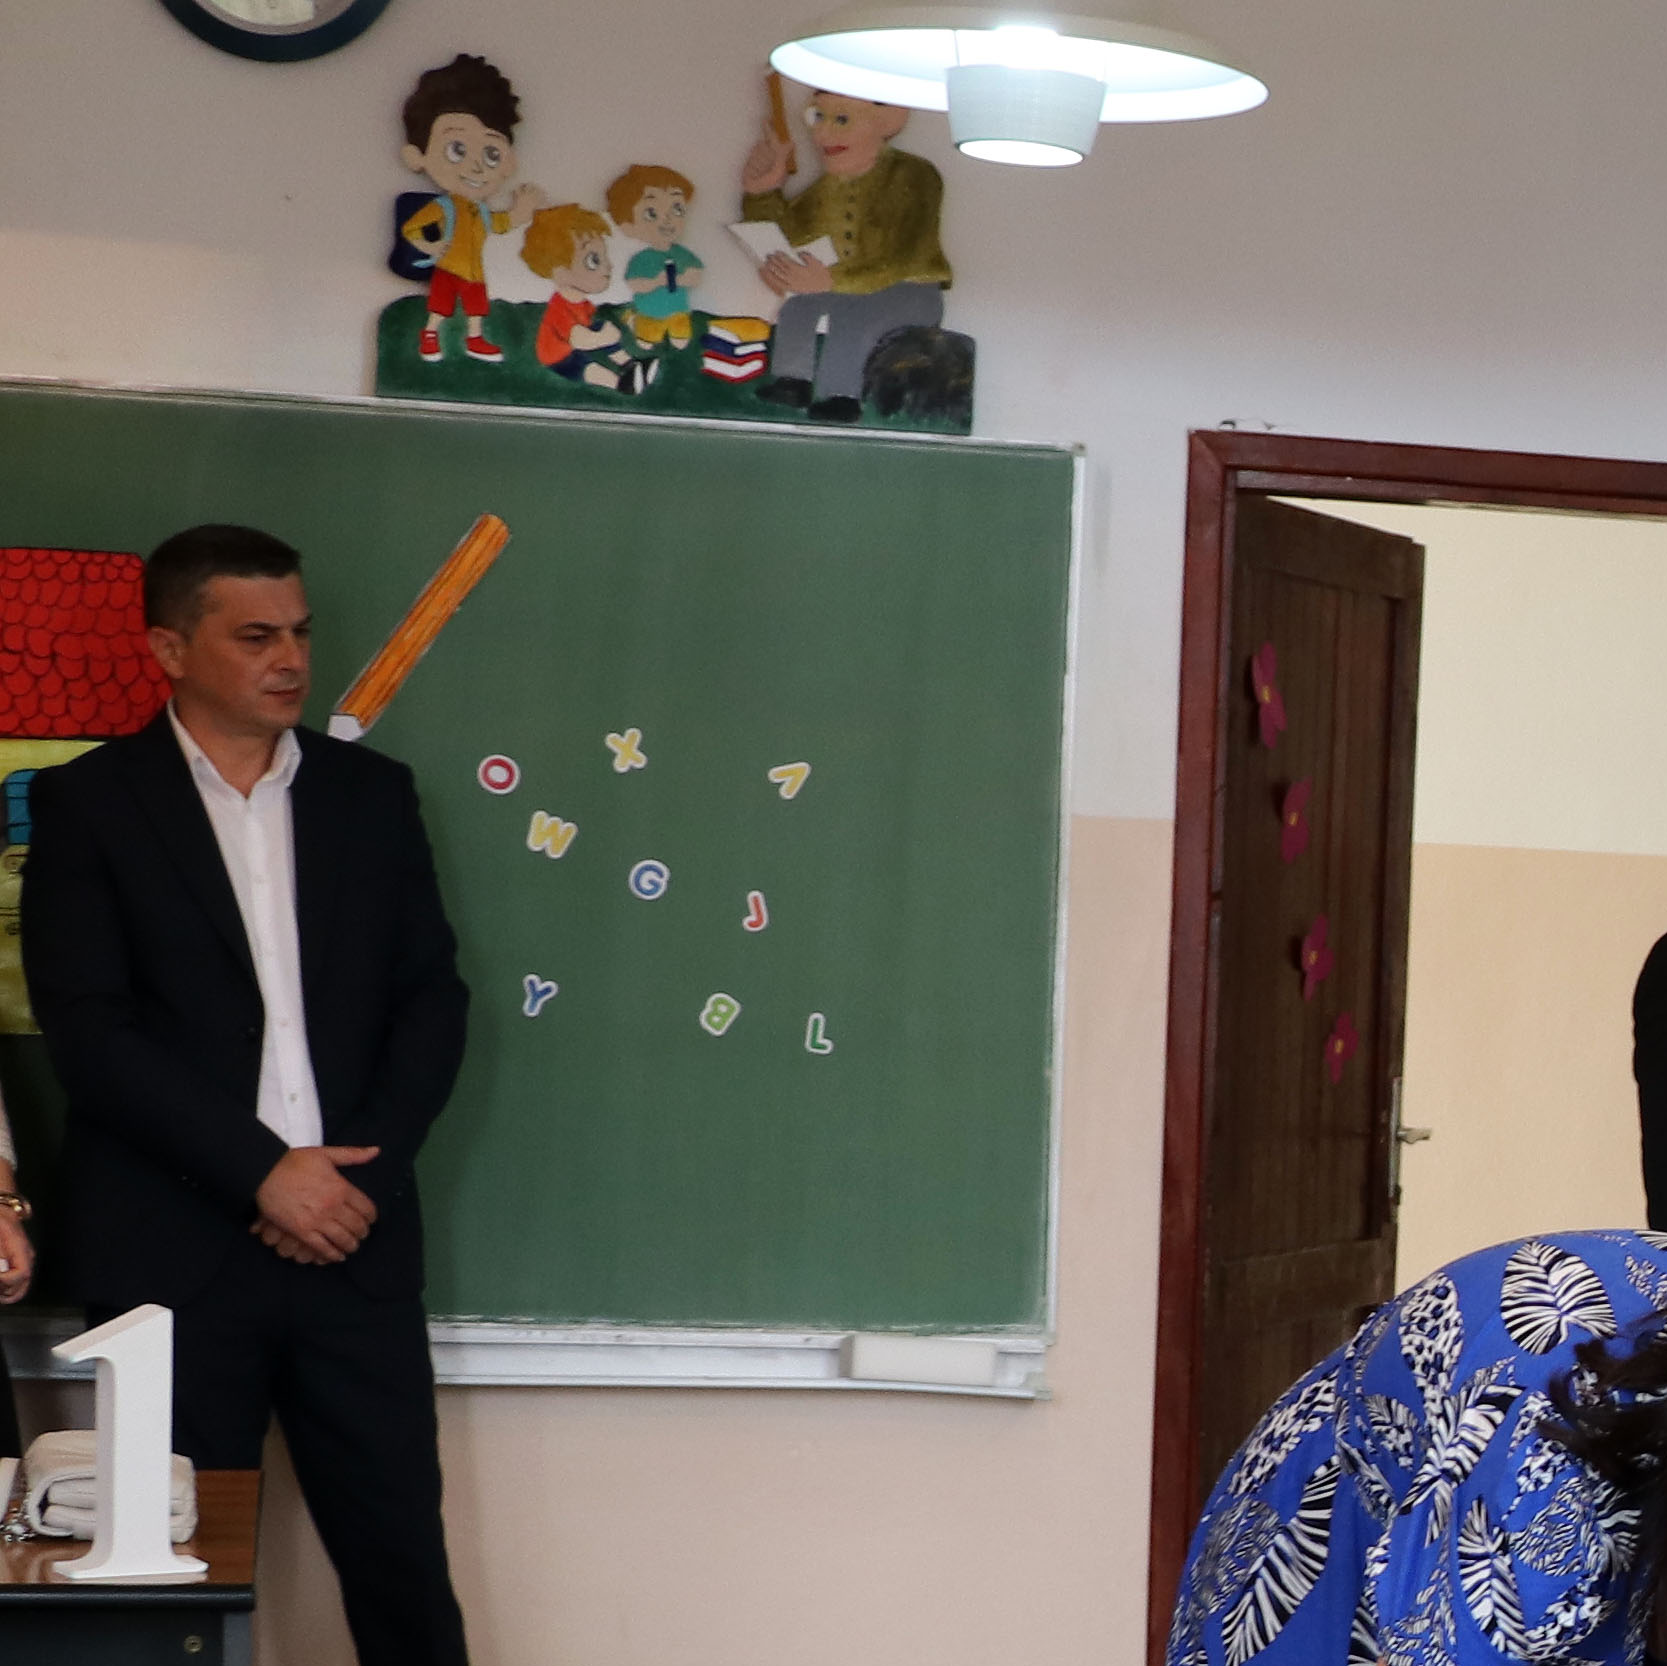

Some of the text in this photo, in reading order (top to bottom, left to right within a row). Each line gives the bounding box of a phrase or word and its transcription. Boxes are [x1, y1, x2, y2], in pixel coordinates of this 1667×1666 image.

[606, 729, 646, 772] X
[480, 756, 519, 793] O
[528, 812, 577, 857] W
[631, 861, 667, 898] G
[744, 892, 767, 930] J
[524, 975, 557, 1015] Y
[701, 994, 740, 1034] B
[807, 1013, 832, 1053] L
[51, 1303, 209, 1580] 1
